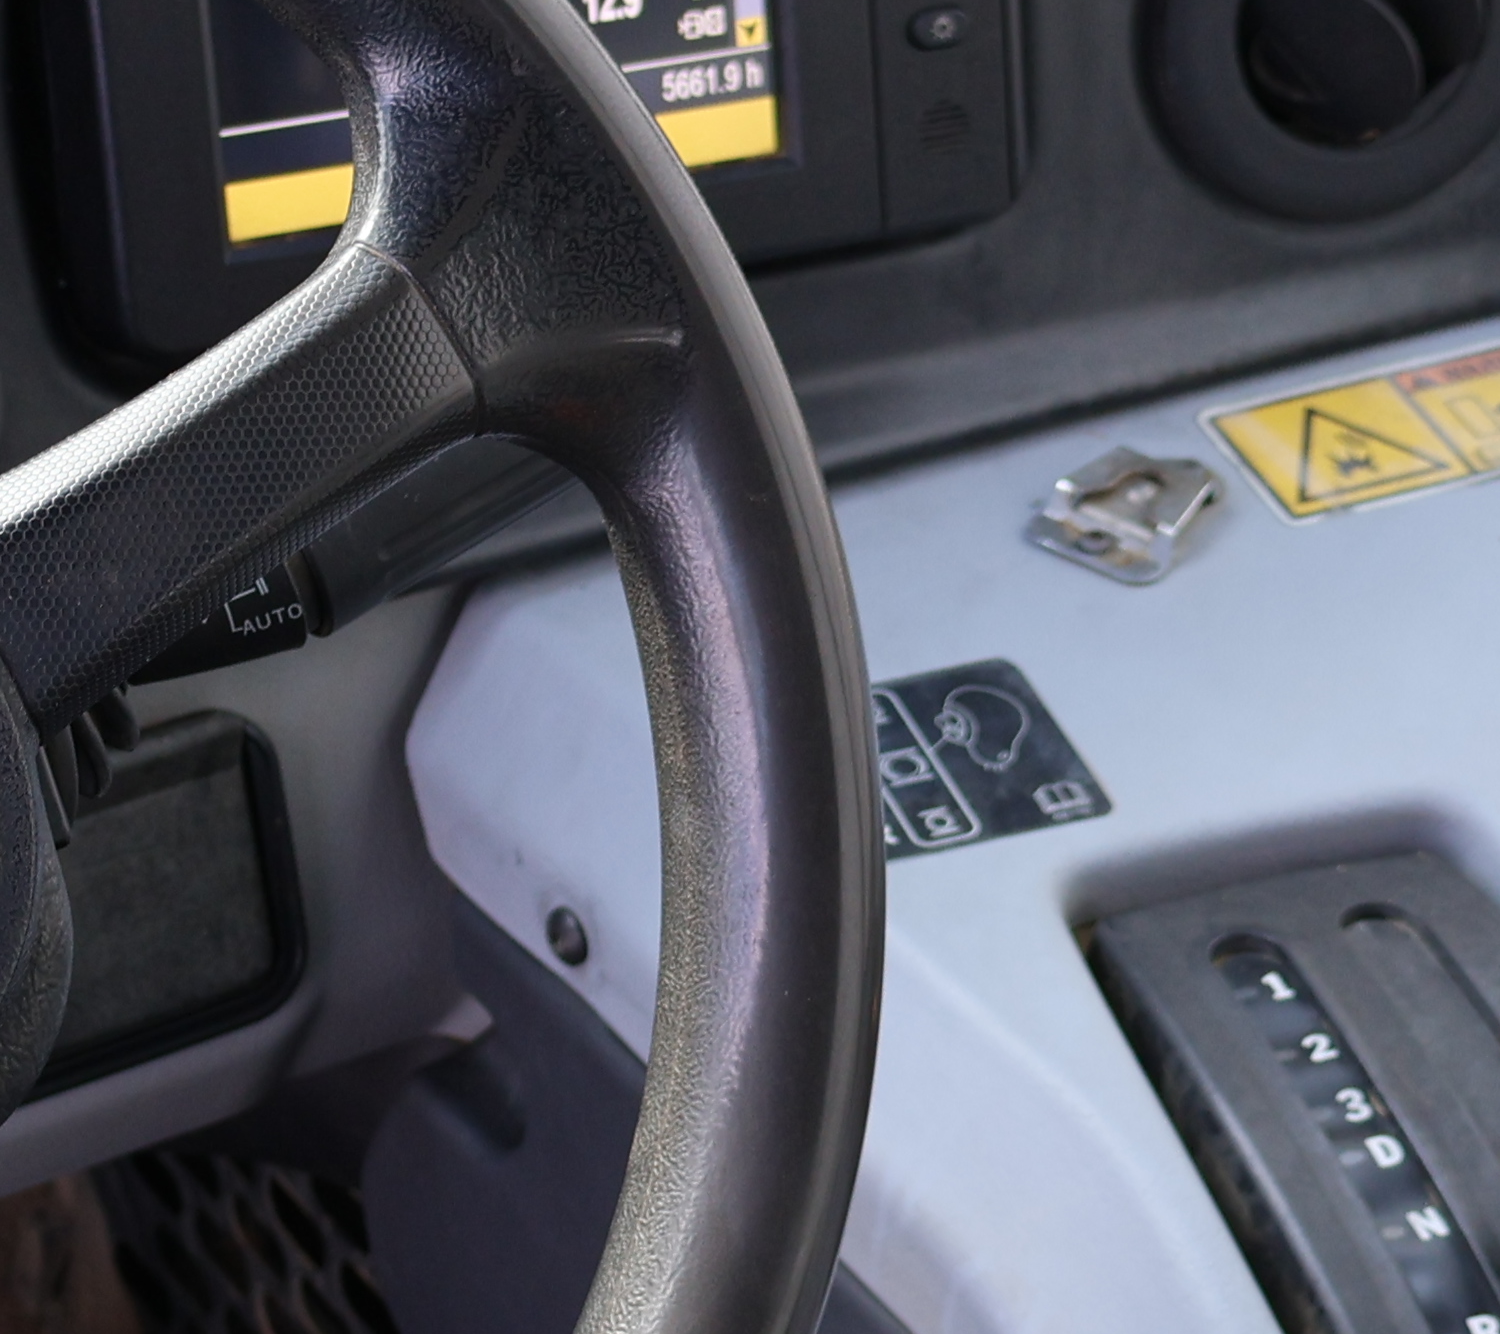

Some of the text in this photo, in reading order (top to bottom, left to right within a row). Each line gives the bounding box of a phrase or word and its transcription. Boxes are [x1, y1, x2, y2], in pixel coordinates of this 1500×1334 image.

[661, 59, 765, 102] 5661.9 h
[242, 602, 304, 637] AUTO
[1260, 970, 1297, 1002] 1
[1300, 1032, 1341, 1064] 2
[1334, 1086, 1375, 1124] 3
[1363, 1133, 1405, 1169] D
[1404, 1204, 1452, 1242] N
